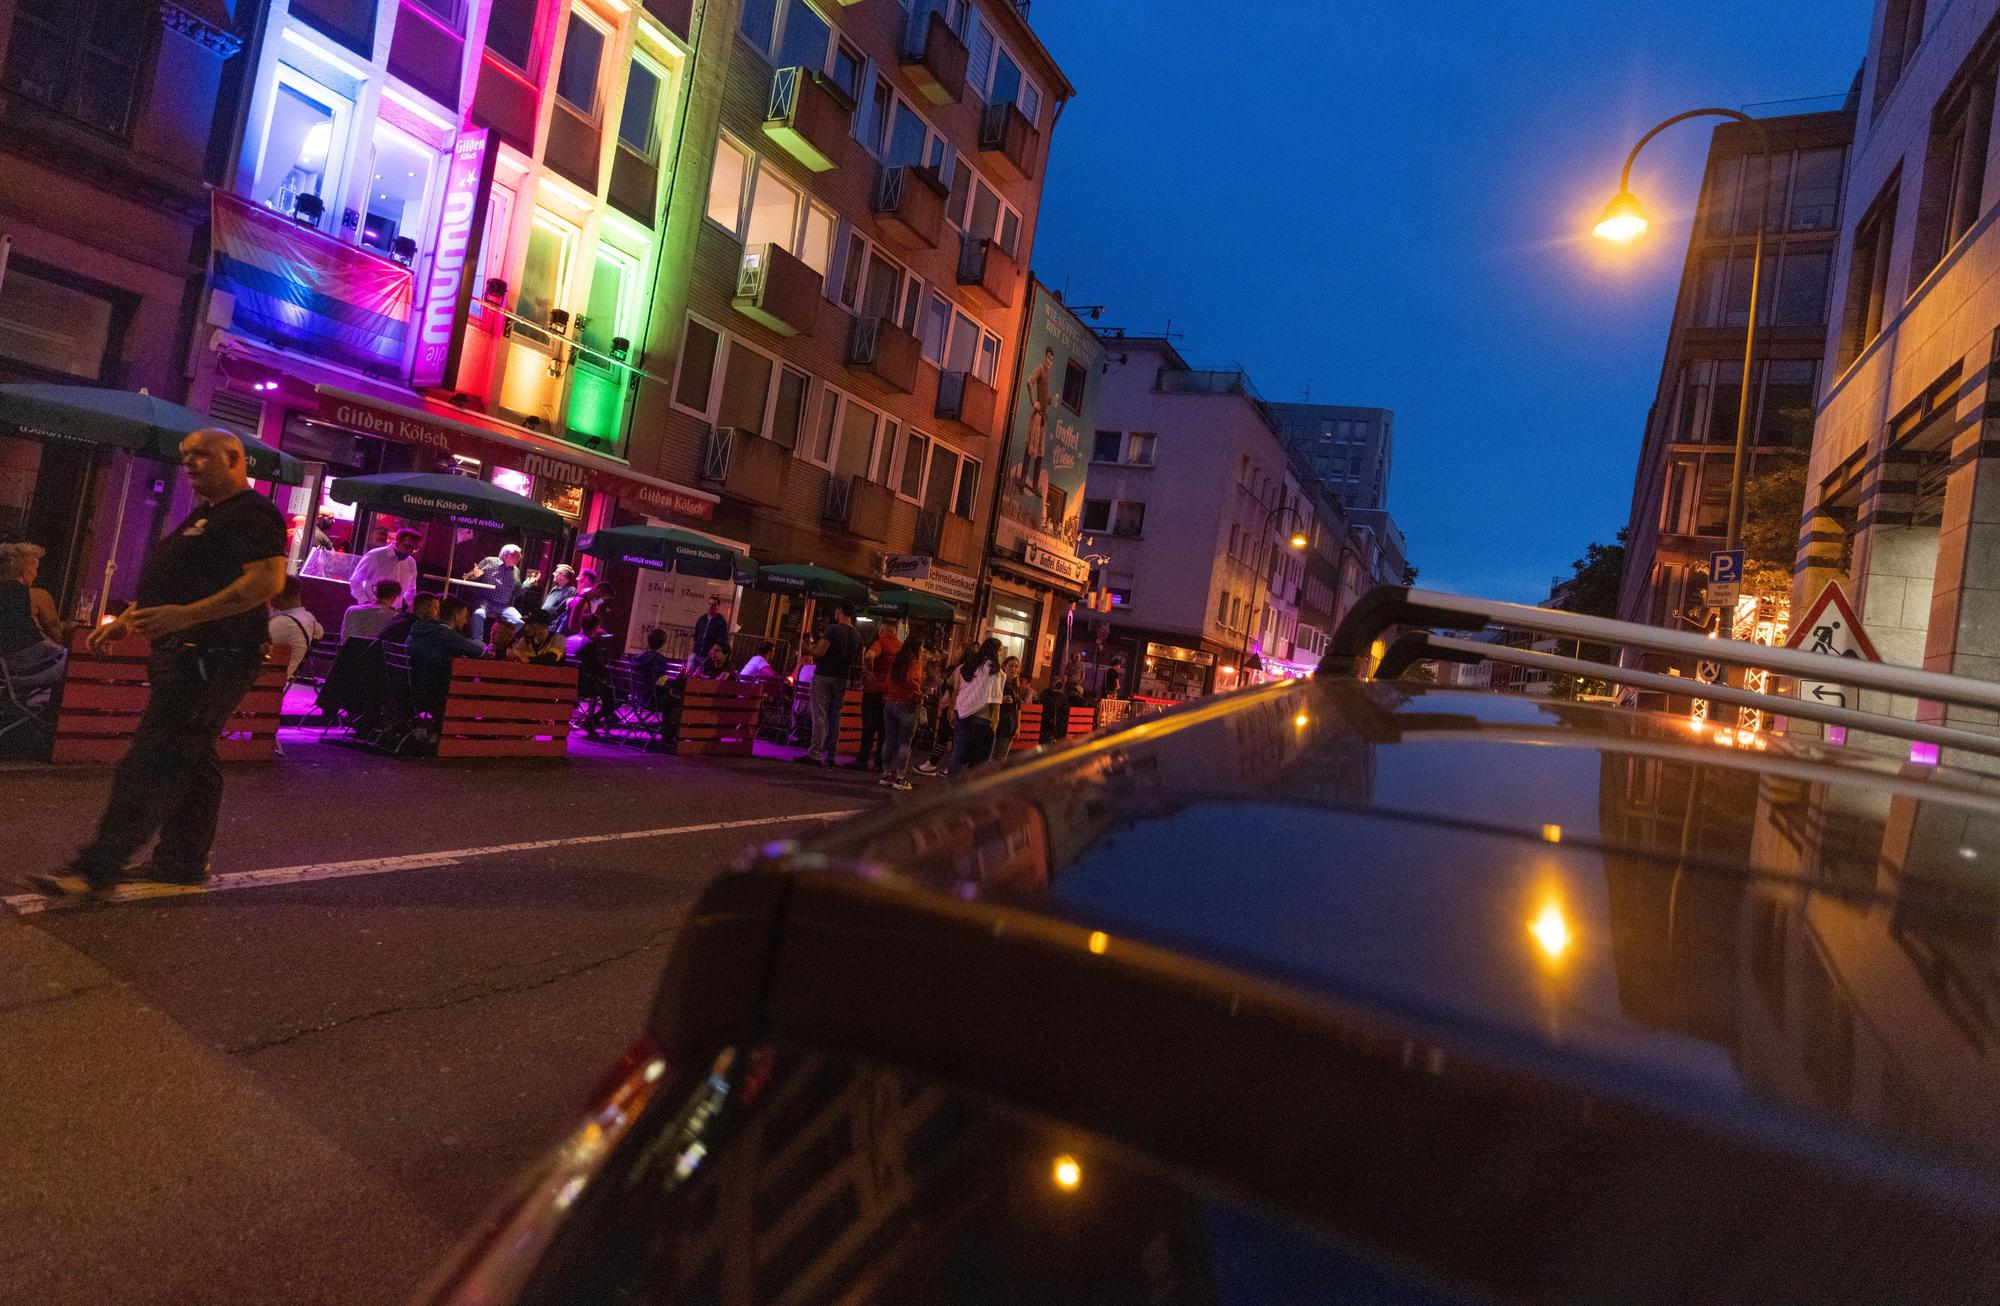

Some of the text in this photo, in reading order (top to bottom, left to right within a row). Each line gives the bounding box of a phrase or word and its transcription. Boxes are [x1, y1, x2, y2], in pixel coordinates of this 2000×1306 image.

[456, 138, 486, 154] Gilden
[337, 405, 450, 449] Gilden Kölsch
[1055, 419, 1080, 451] Gaffel
[403, 494, 468, 512] Gilden Kölsch
[640, 486, 704, 515] Gilden Kölsch
[676, 546, 721, 561] Gilden Kölsch
[1040, 552, 1055, 570] Gaffel
[1713, 555, 1734, 582] P
